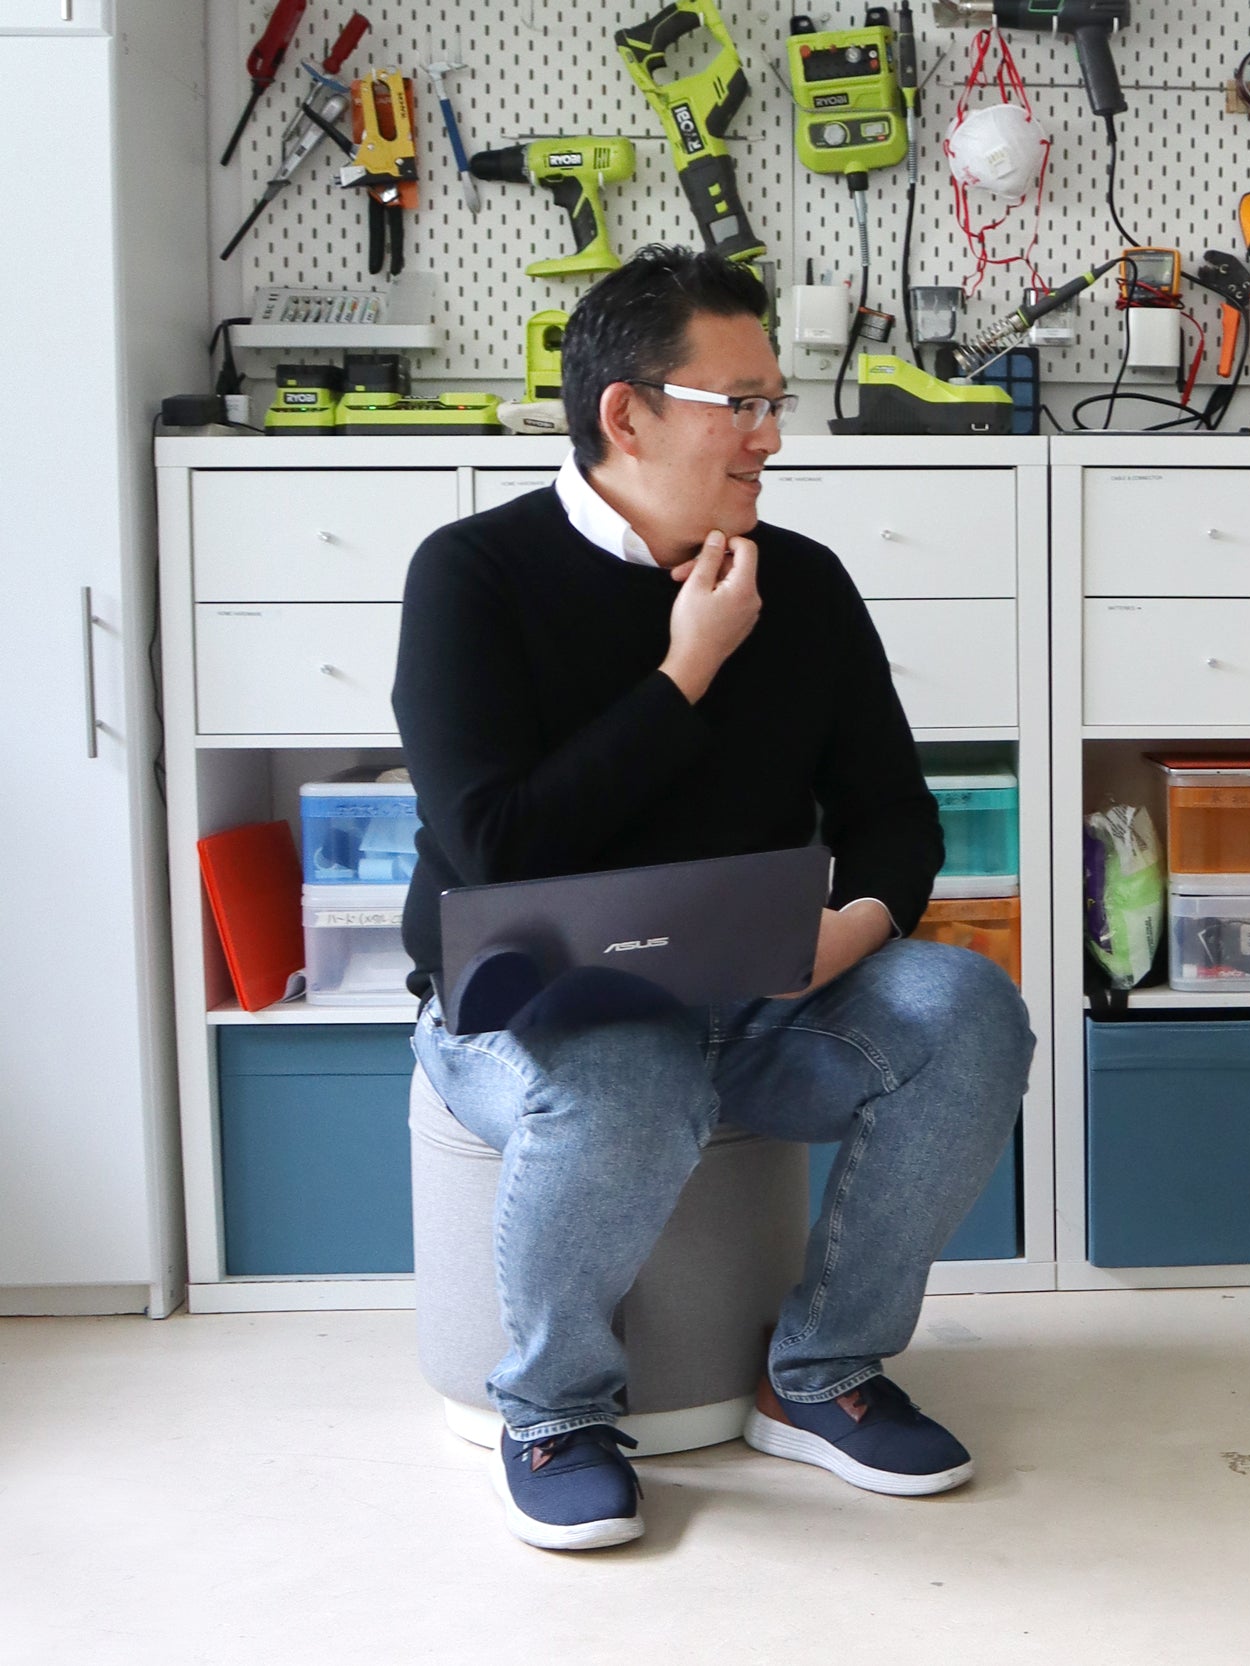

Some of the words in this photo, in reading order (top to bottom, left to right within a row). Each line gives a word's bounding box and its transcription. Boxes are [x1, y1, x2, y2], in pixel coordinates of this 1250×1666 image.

[814, 94, 848, 106] RYOBI
[674, 106, 702, 152] RYOBI
[550, 154, 581, 166] RYOBI
[285, 393, 317, 403] RYOBI
[603, 937, 669, 953] ASUS
